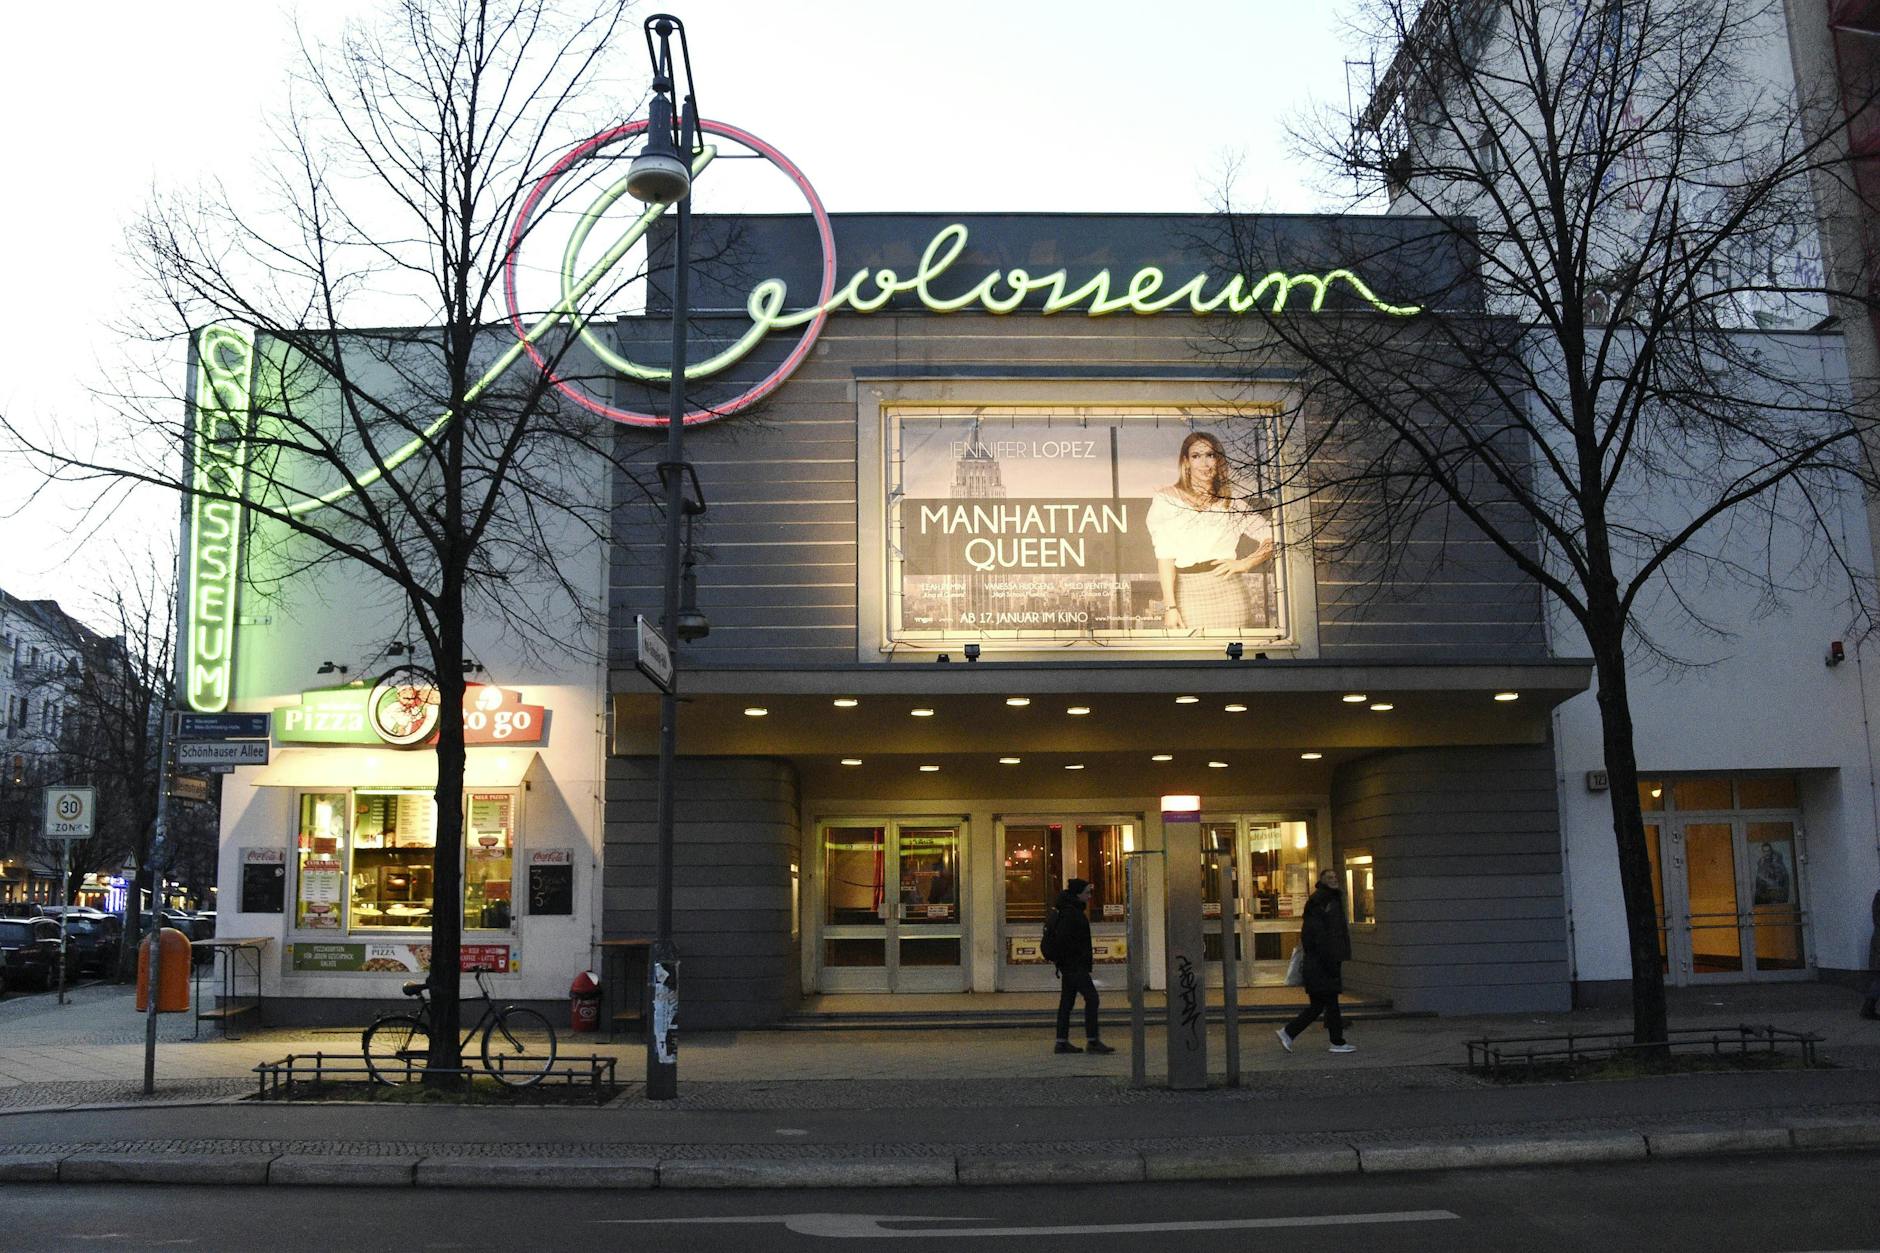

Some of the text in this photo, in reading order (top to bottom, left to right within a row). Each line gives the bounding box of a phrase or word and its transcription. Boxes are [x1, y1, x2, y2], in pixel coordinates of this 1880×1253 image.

[505, 142, 1425, 422] Colosseum
[950, 441, 1097, 459] JENNIFER LOPEZ
[194, 335, 247, 700] COLOSSEUM
[920, 504, 1128, 534] MANHATTAN
[964, 537, 1086, 572] QUEEN
[960, 612, 976, 624] AB
[979, 612, 994, 624] 17.
[995, 612, 1040, 625] JANUAR
[1042, 612, 1056, 623] IM
[1057, 611, 1089, 623] KINO
[284, 706, 365, 732] Pizza
[493, 710, 532, 739] go
[181, 744, 264, 758] Schönhauser Allee
[61, 800, 78, 814] 30
